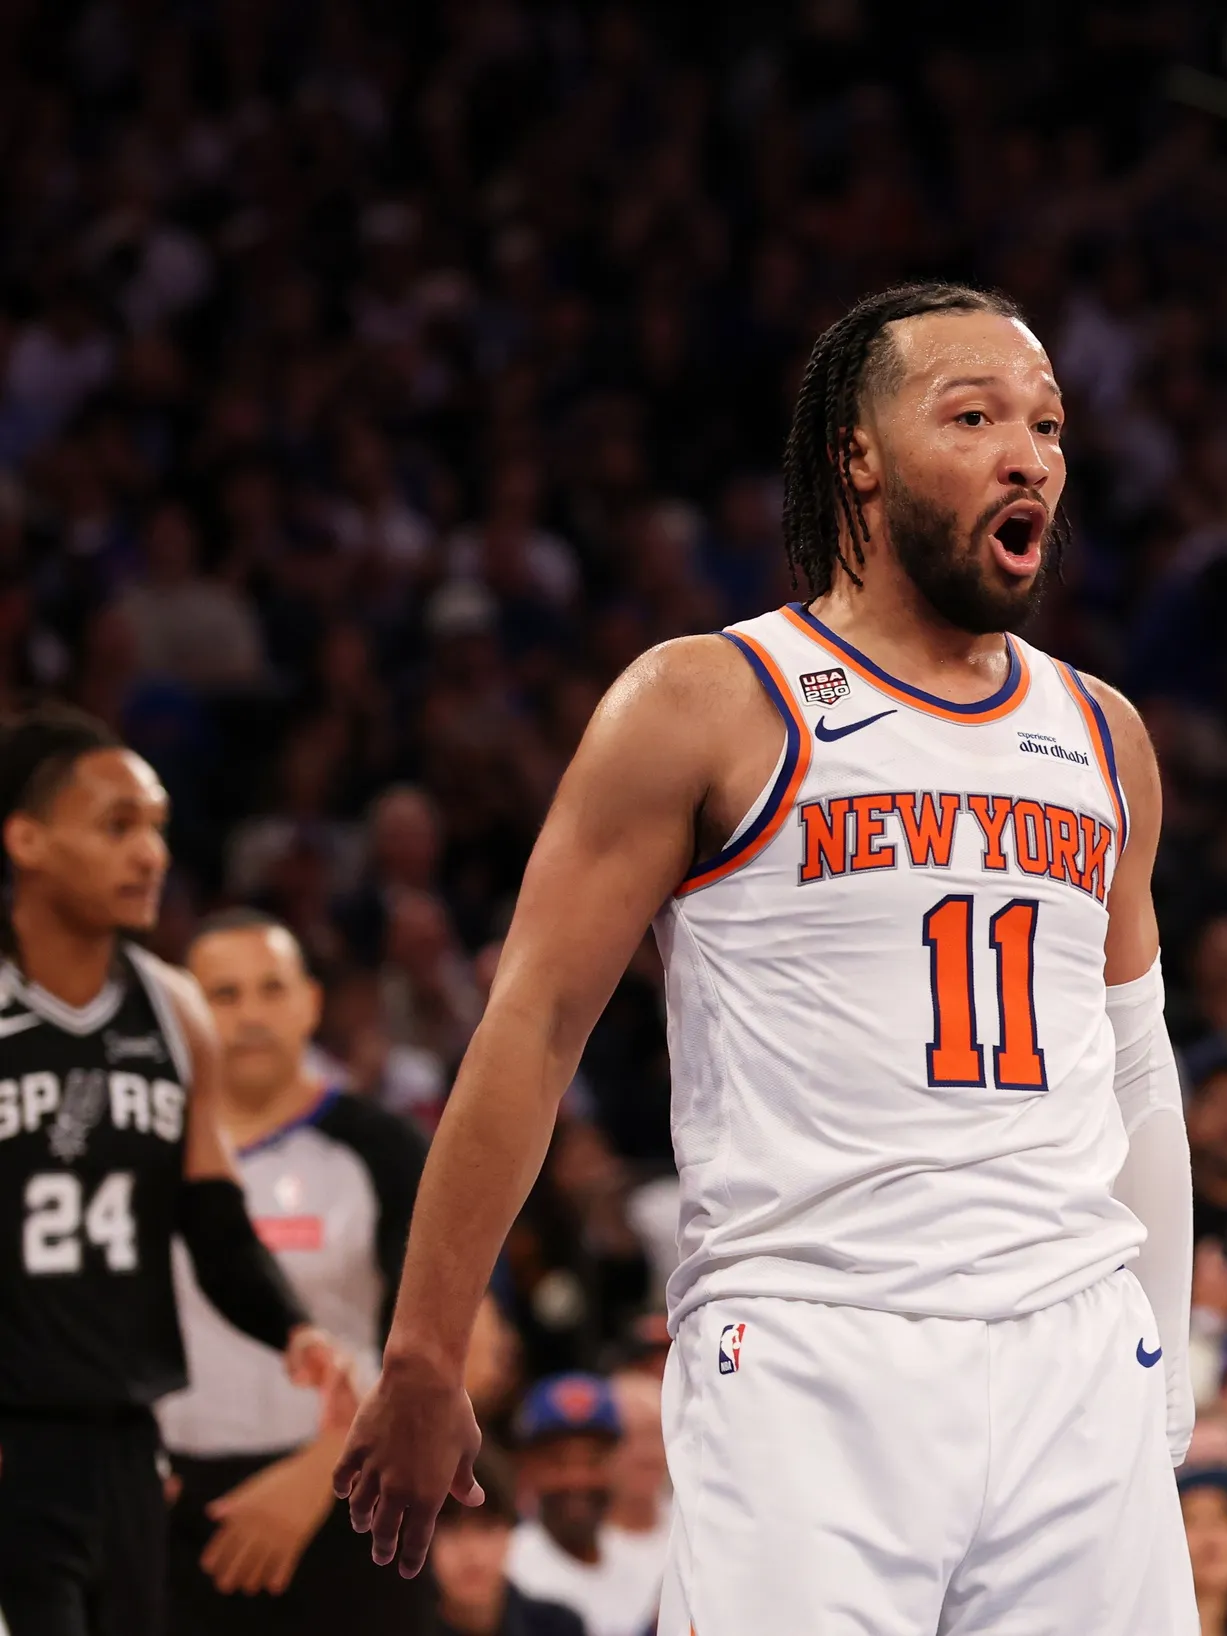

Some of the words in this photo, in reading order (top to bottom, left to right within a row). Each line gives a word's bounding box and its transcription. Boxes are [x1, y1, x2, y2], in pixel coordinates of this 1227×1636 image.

[803, 671, 842, 685] USA
[805, 685, 849, 701] 250
[1017, 731, 1057, 743] experience
[1019, 740, 1049, 755] abu
[1050, 744, 1089, 766] dhabi
[797, 789, 961, 888] NEW
[962, 792, 1115, 903] YORK
[922, 893, 1050, 1092] 11
[23, 1171, 138, 1275] 24
